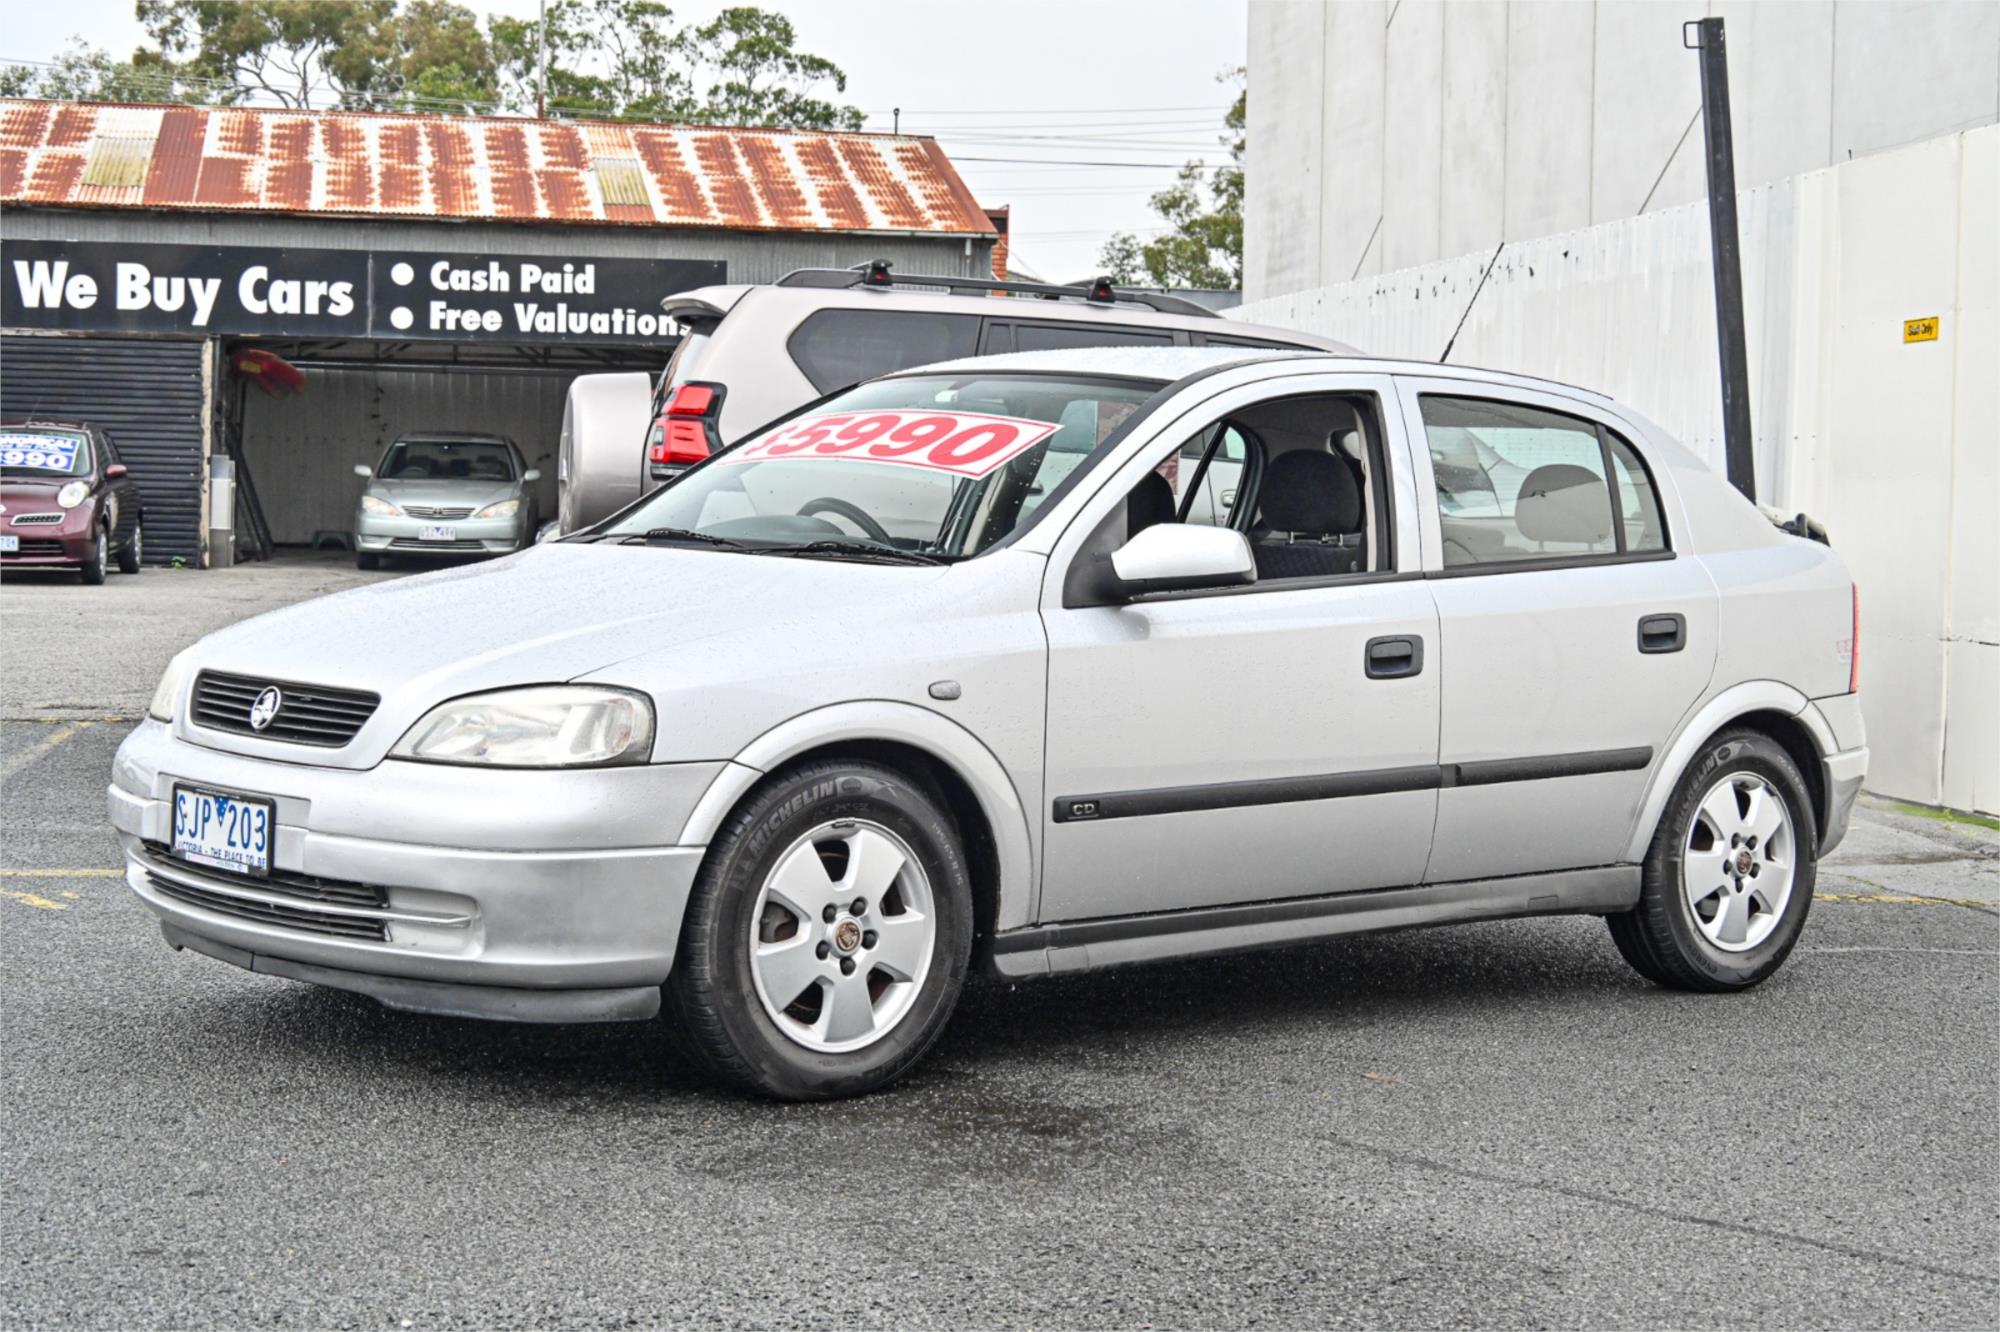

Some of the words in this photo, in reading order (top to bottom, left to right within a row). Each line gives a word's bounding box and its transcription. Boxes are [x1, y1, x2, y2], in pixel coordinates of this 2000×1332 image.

[13, 260, 98, 310] We
[116, 262, 222, 326] Buy
[238, 266, 355, 316] Cars
[430, 261, 510, 293] Cash
[520, 264, 595, 294] Paid
[429, 300, 503, 332] Free
[744, 414, 1019, 466] $5990
[177, 794, 211, 841] SJP
[227, 804, 266, 852] 203
[747, 780, 835, 856] MICHELIN
[1072, 803, 1095, 815] CD
